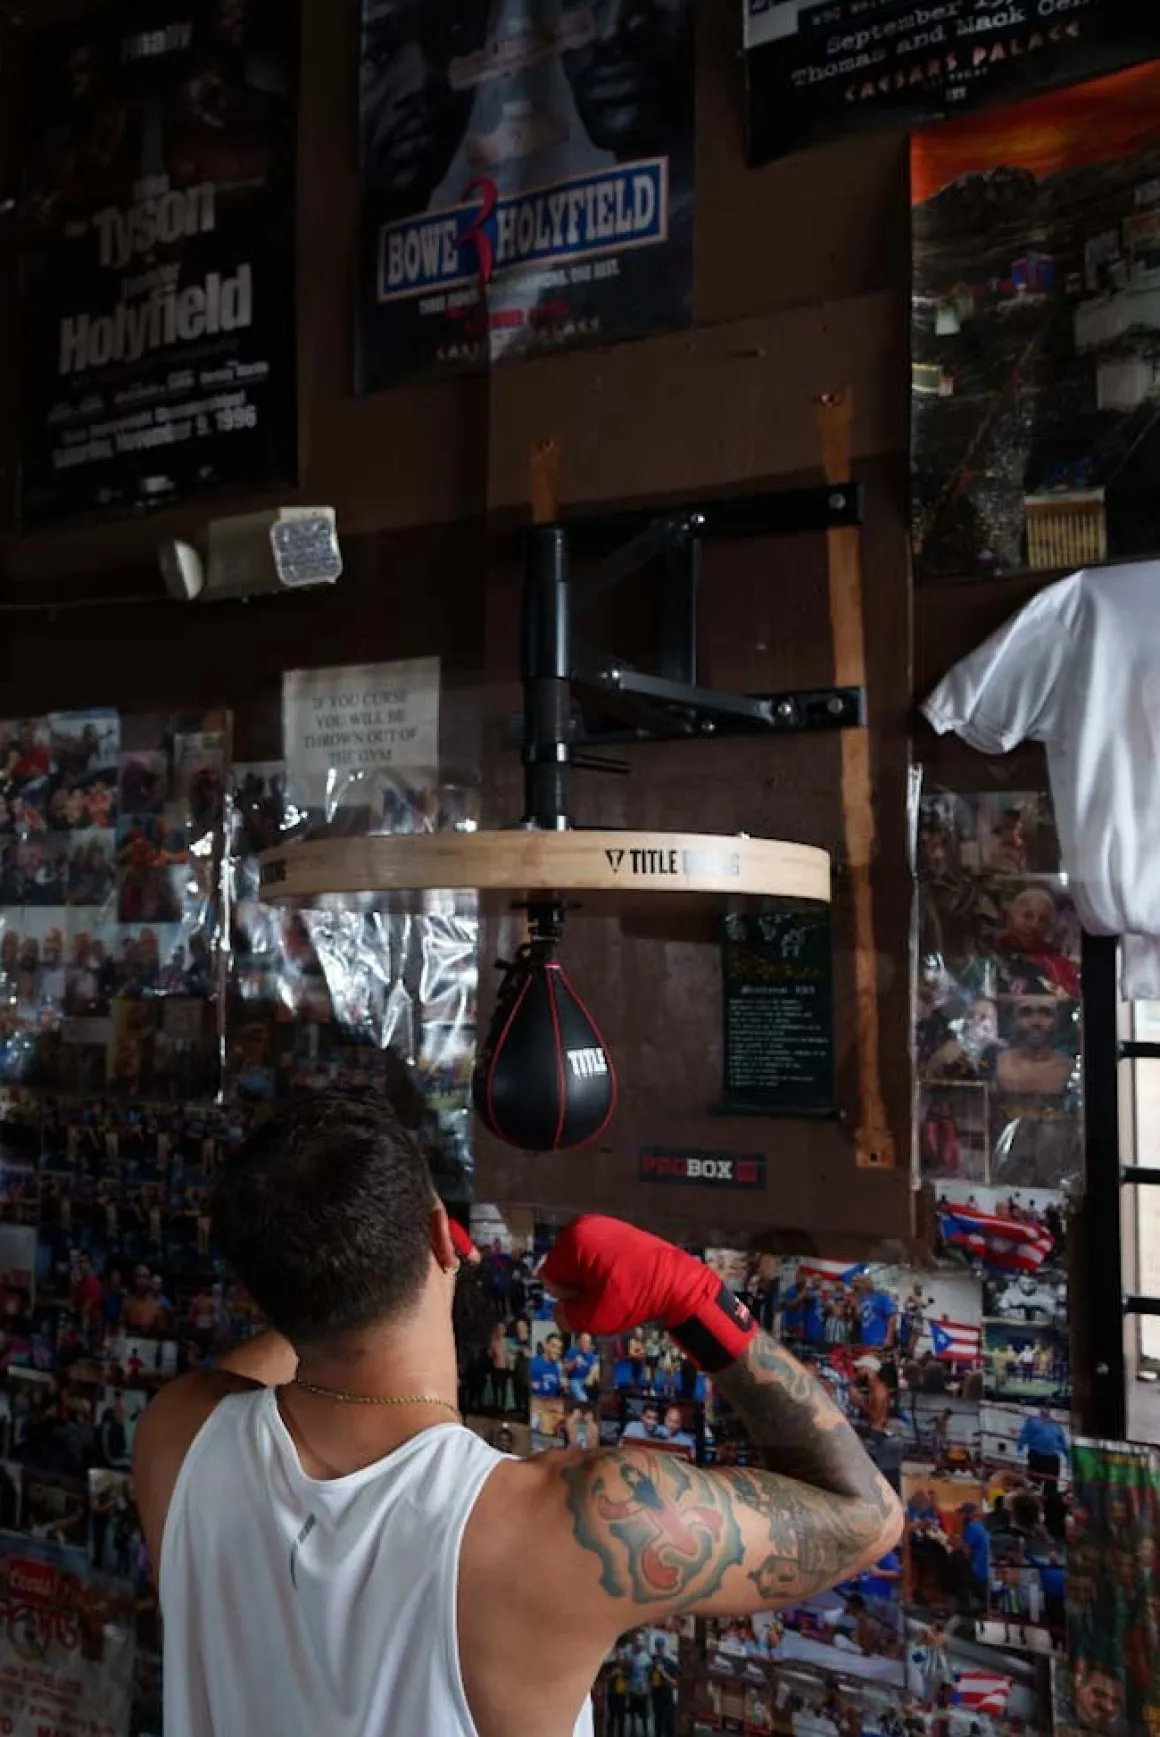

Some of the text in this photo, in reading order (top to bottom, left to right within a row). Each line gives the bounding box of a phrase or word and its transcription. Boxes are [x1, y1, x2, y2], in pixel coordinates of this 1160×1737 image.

[826, 1, 963, 54] September
[790, 49, 886, 88] Thomas
[896, 25, 946, 54] and
[844, 52, 959, 102] CAESARS
[972, 20, 1080, 67] PALACE
[92, 181, 215, 268] Tyson
[387, 219, 459, 286] BOWE
[497, 174, 656, 261] HOLYFIELD
[59, 263, 252, 376] Holyfield
[316, 708, 405, 729] YOU WILL BE
[328, 694, 360, 708] YOU
[362, 689, 408, 706] CURSE
[303, 727, 417, 749] THROWN OUT OF
[629, 850, 678, 874] TITLE
[566, 1048, 607, 1078] TITLE
